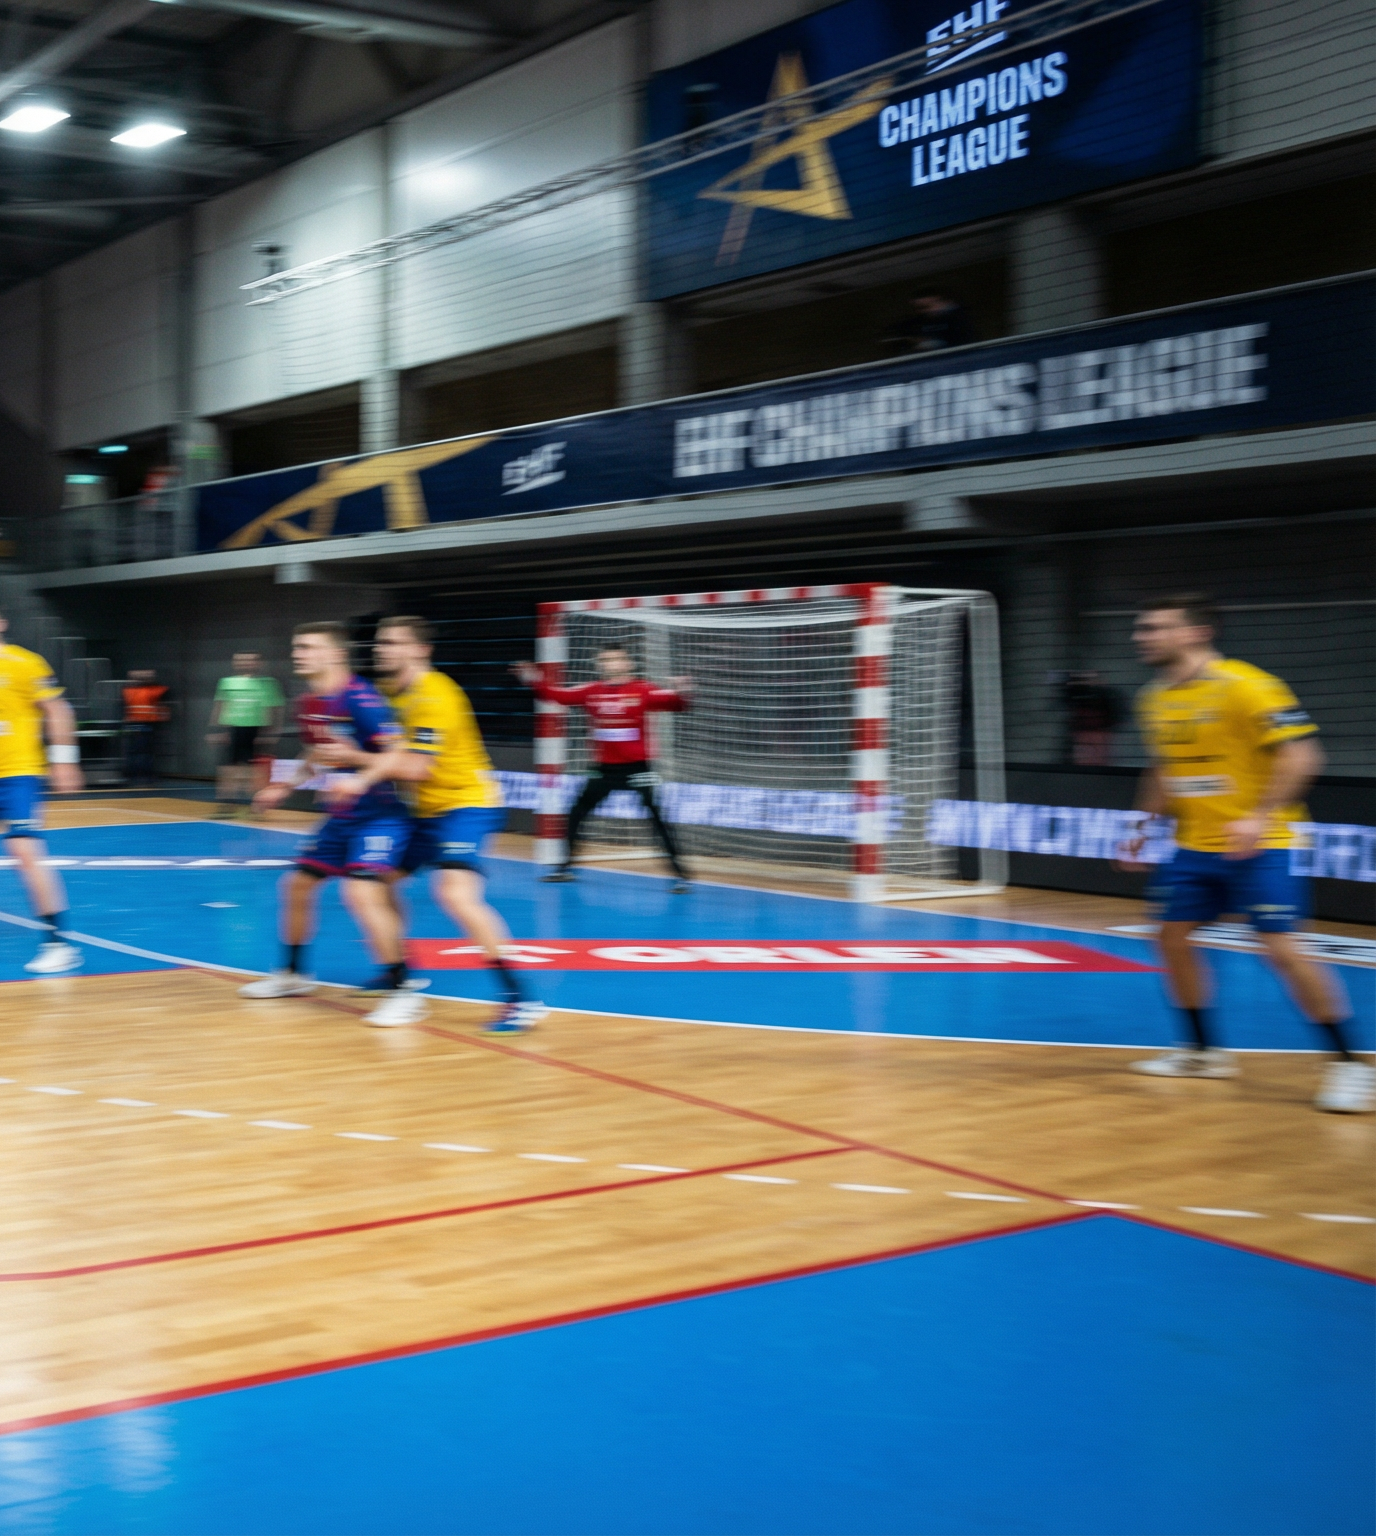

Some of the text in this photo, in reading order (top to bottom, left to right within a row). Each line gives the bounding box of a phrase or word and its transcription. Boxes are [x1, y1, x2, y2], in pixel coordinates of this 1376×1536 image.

[879, 51, 1068, 148] CHAMPIONS
[911, 113, 1030, 187] LEAGUE
[1037, 321, 1270, 432] LEAGUE
[587, 945, 1078, 964] ORLEN
